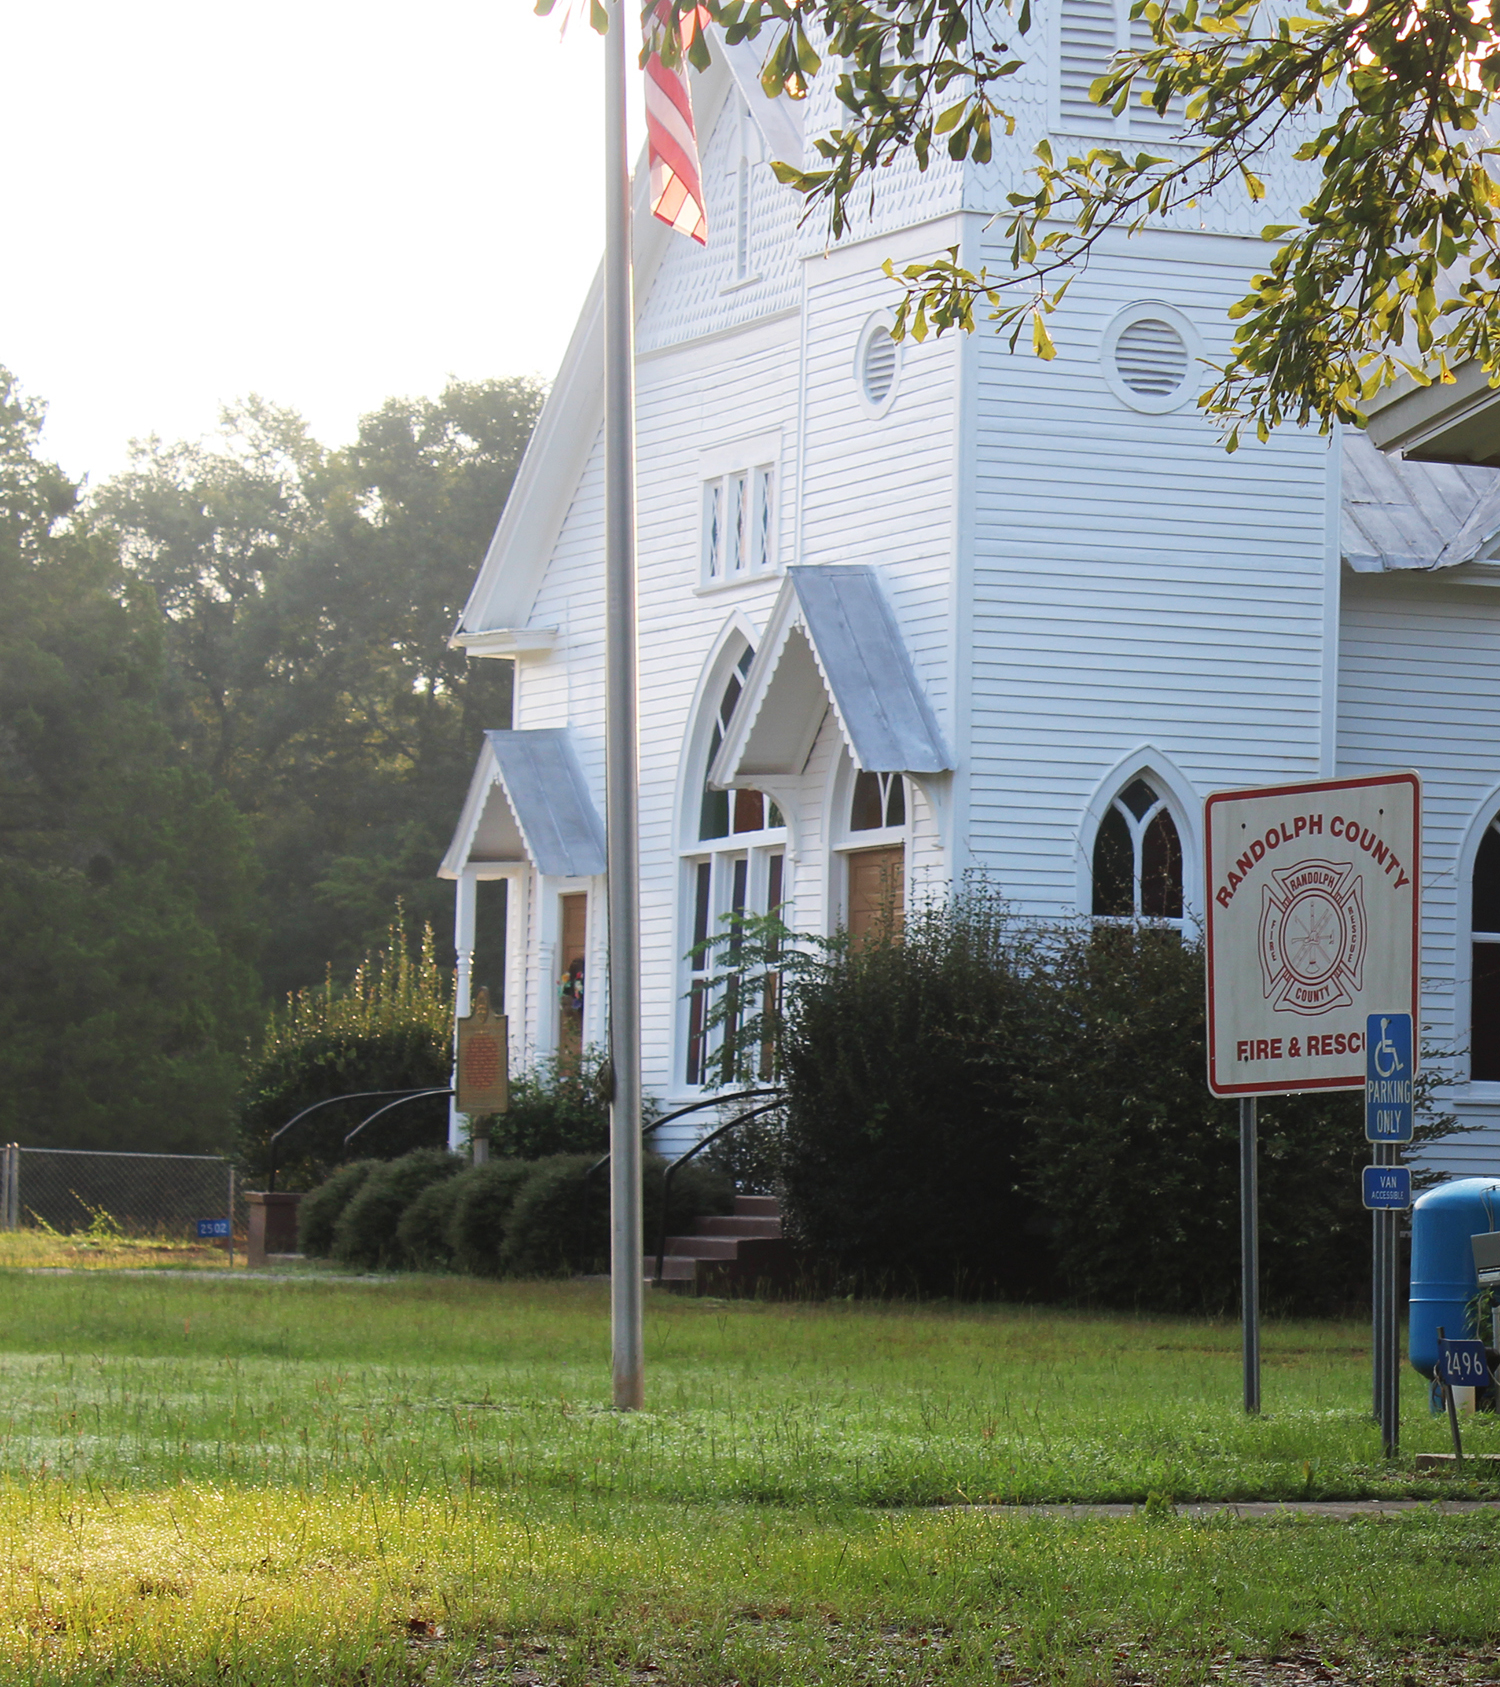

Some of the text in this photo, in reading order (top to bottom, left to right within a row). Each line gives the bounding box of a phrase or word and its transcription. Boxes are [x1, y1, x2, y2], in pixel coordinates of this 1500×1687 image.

[1215, 814, 1411, 910] RANDOLPH COUNTY
[1290, 871, 1335, 892] RANDOLPH
[1269, 919, 1277, 962] FIRE
[1347, 906, 1357, 963] RESCUE
[1295, 984, 1331, 1003] COUNTY
[1236, 1032, 1365, 1062] FIRE & RESC
[1367, 1080, 1411, 1104] PARKING
[1376, 1109, 1402, 1134] ONLY
[1380, 1175, 1397, 1189] VAN
[1371, 1190, 1405, 1200] ACCESSIBLE
[200, 1223, 228, 1235] 2502
[1445, 1350, 1484, 1376] 2496
